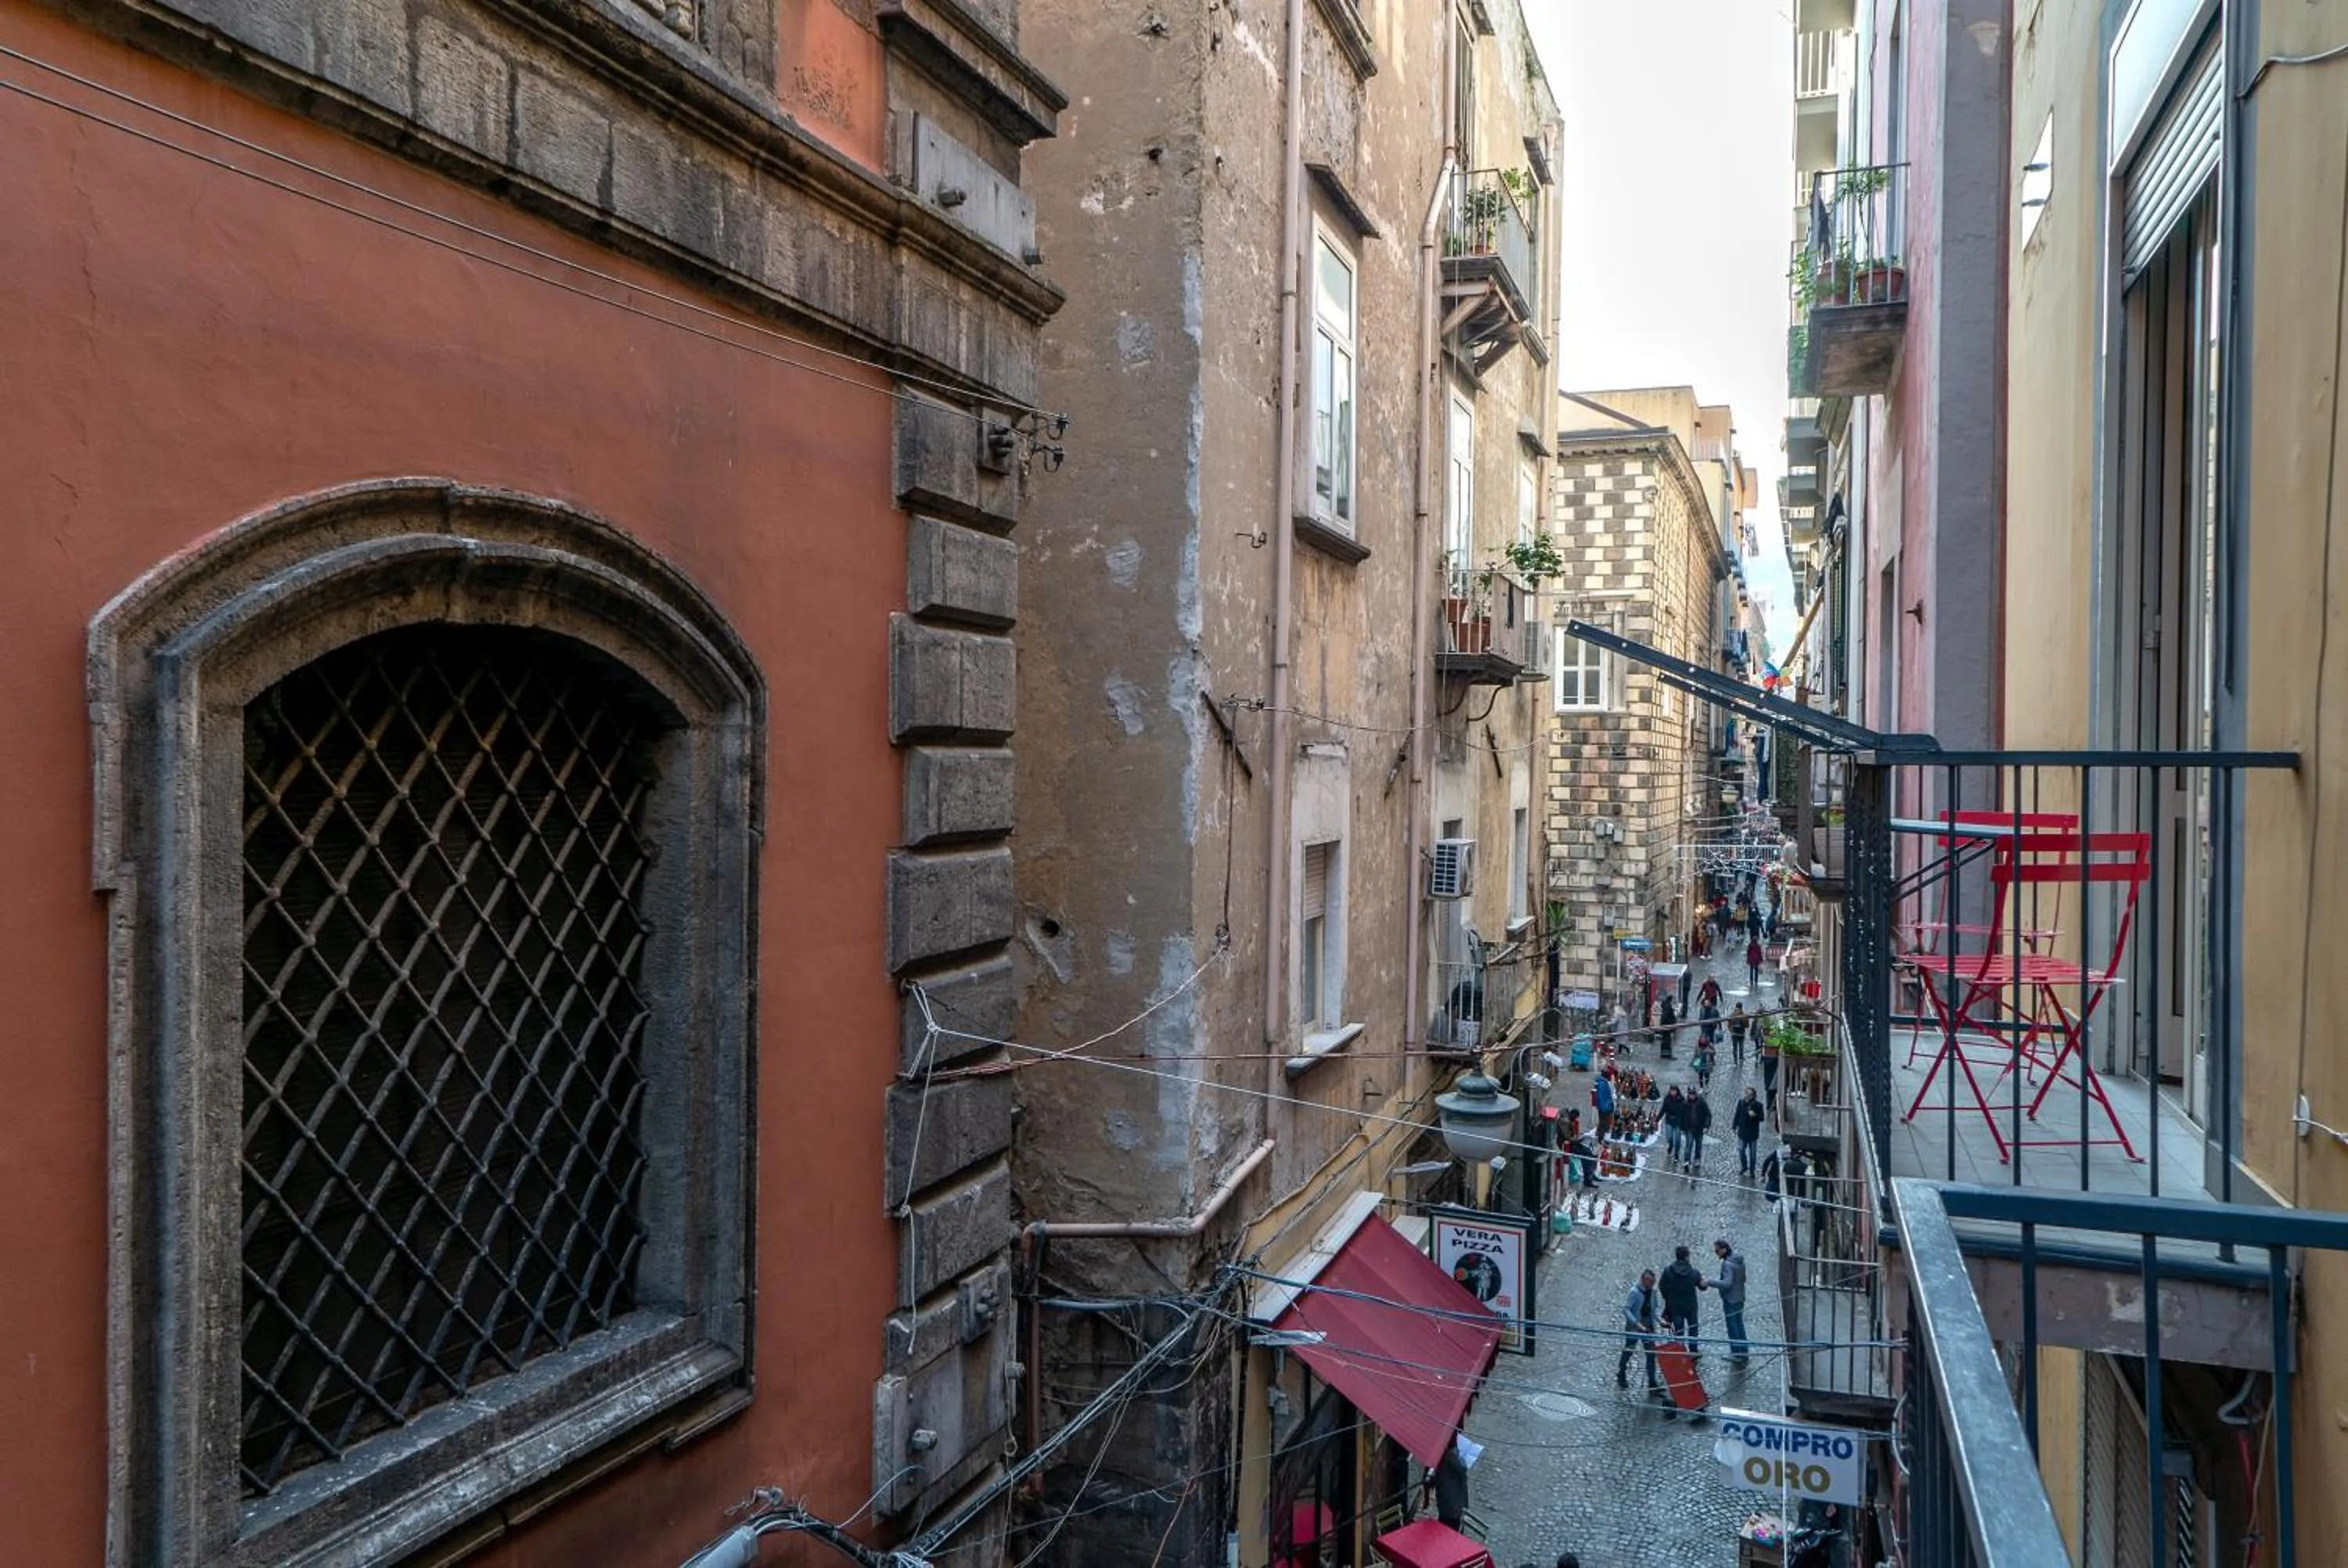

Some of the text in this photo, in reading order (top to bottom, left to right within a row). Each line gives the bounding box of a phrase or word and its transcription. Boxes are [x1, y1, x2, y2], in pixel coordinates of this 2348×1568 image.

[1453, 1228, 1503, 1243] VERA
[1452, 1239, 1504, 1253] PIZZA
[1744, 1456, 1831, 1494] ORO
